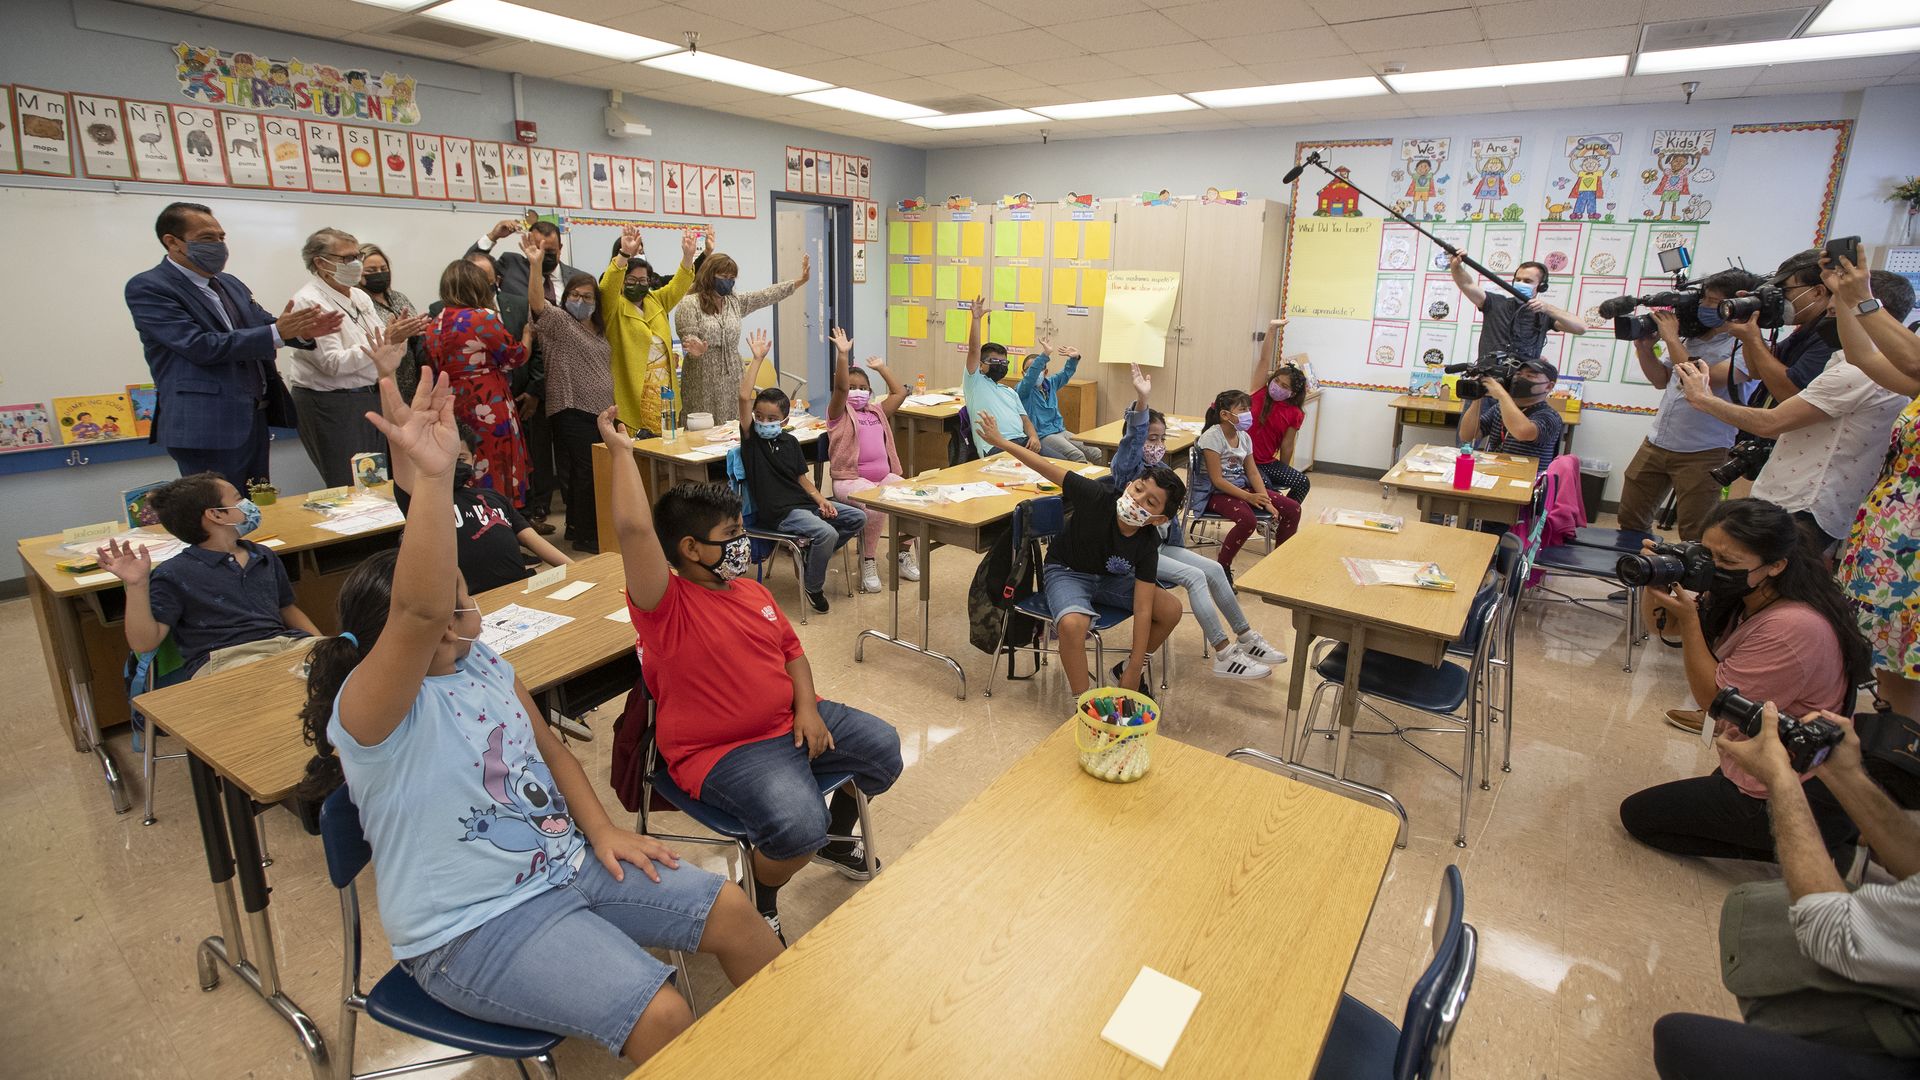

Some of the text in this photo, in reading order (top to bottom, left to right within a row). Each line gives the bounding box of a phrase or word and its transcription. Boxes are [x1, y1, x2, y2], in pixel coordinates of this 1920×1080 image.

[18, 92, 38, 110] M
[202, 72, 396, 122] STAR STUDENT
[78, 100, 96, 116] N
[130, 103, 146, 121] Ñ
[177, 111, 194, 126] O
[226, 116, 237, 130] P
[266, 121, 282, 135] Q
[311, 126, 321, 139] R
[349, 130, 358, 143] S
[384, 134, 392, 146] T
[1666, 135, 1700, 149] Kids!
[33, 143, 58, 152] mapa
[416, 138, 425, 151] U
[445, 141, 456, 153] V
[1417, 143, 1435, 155] We
[1486, 143, 1508, 153] Are
[1575, 138, 1612, 155] Super
[475, 146, 487, 157] W
[506, 149, 514, 159] X
[533, 151, 541, 163] Y
[560, 155, 566, 166] Z
[1298, 222, 1314, 233] What
[1318, 222, 1328, 232] Did
[1332, 222, 1341, 233] You
